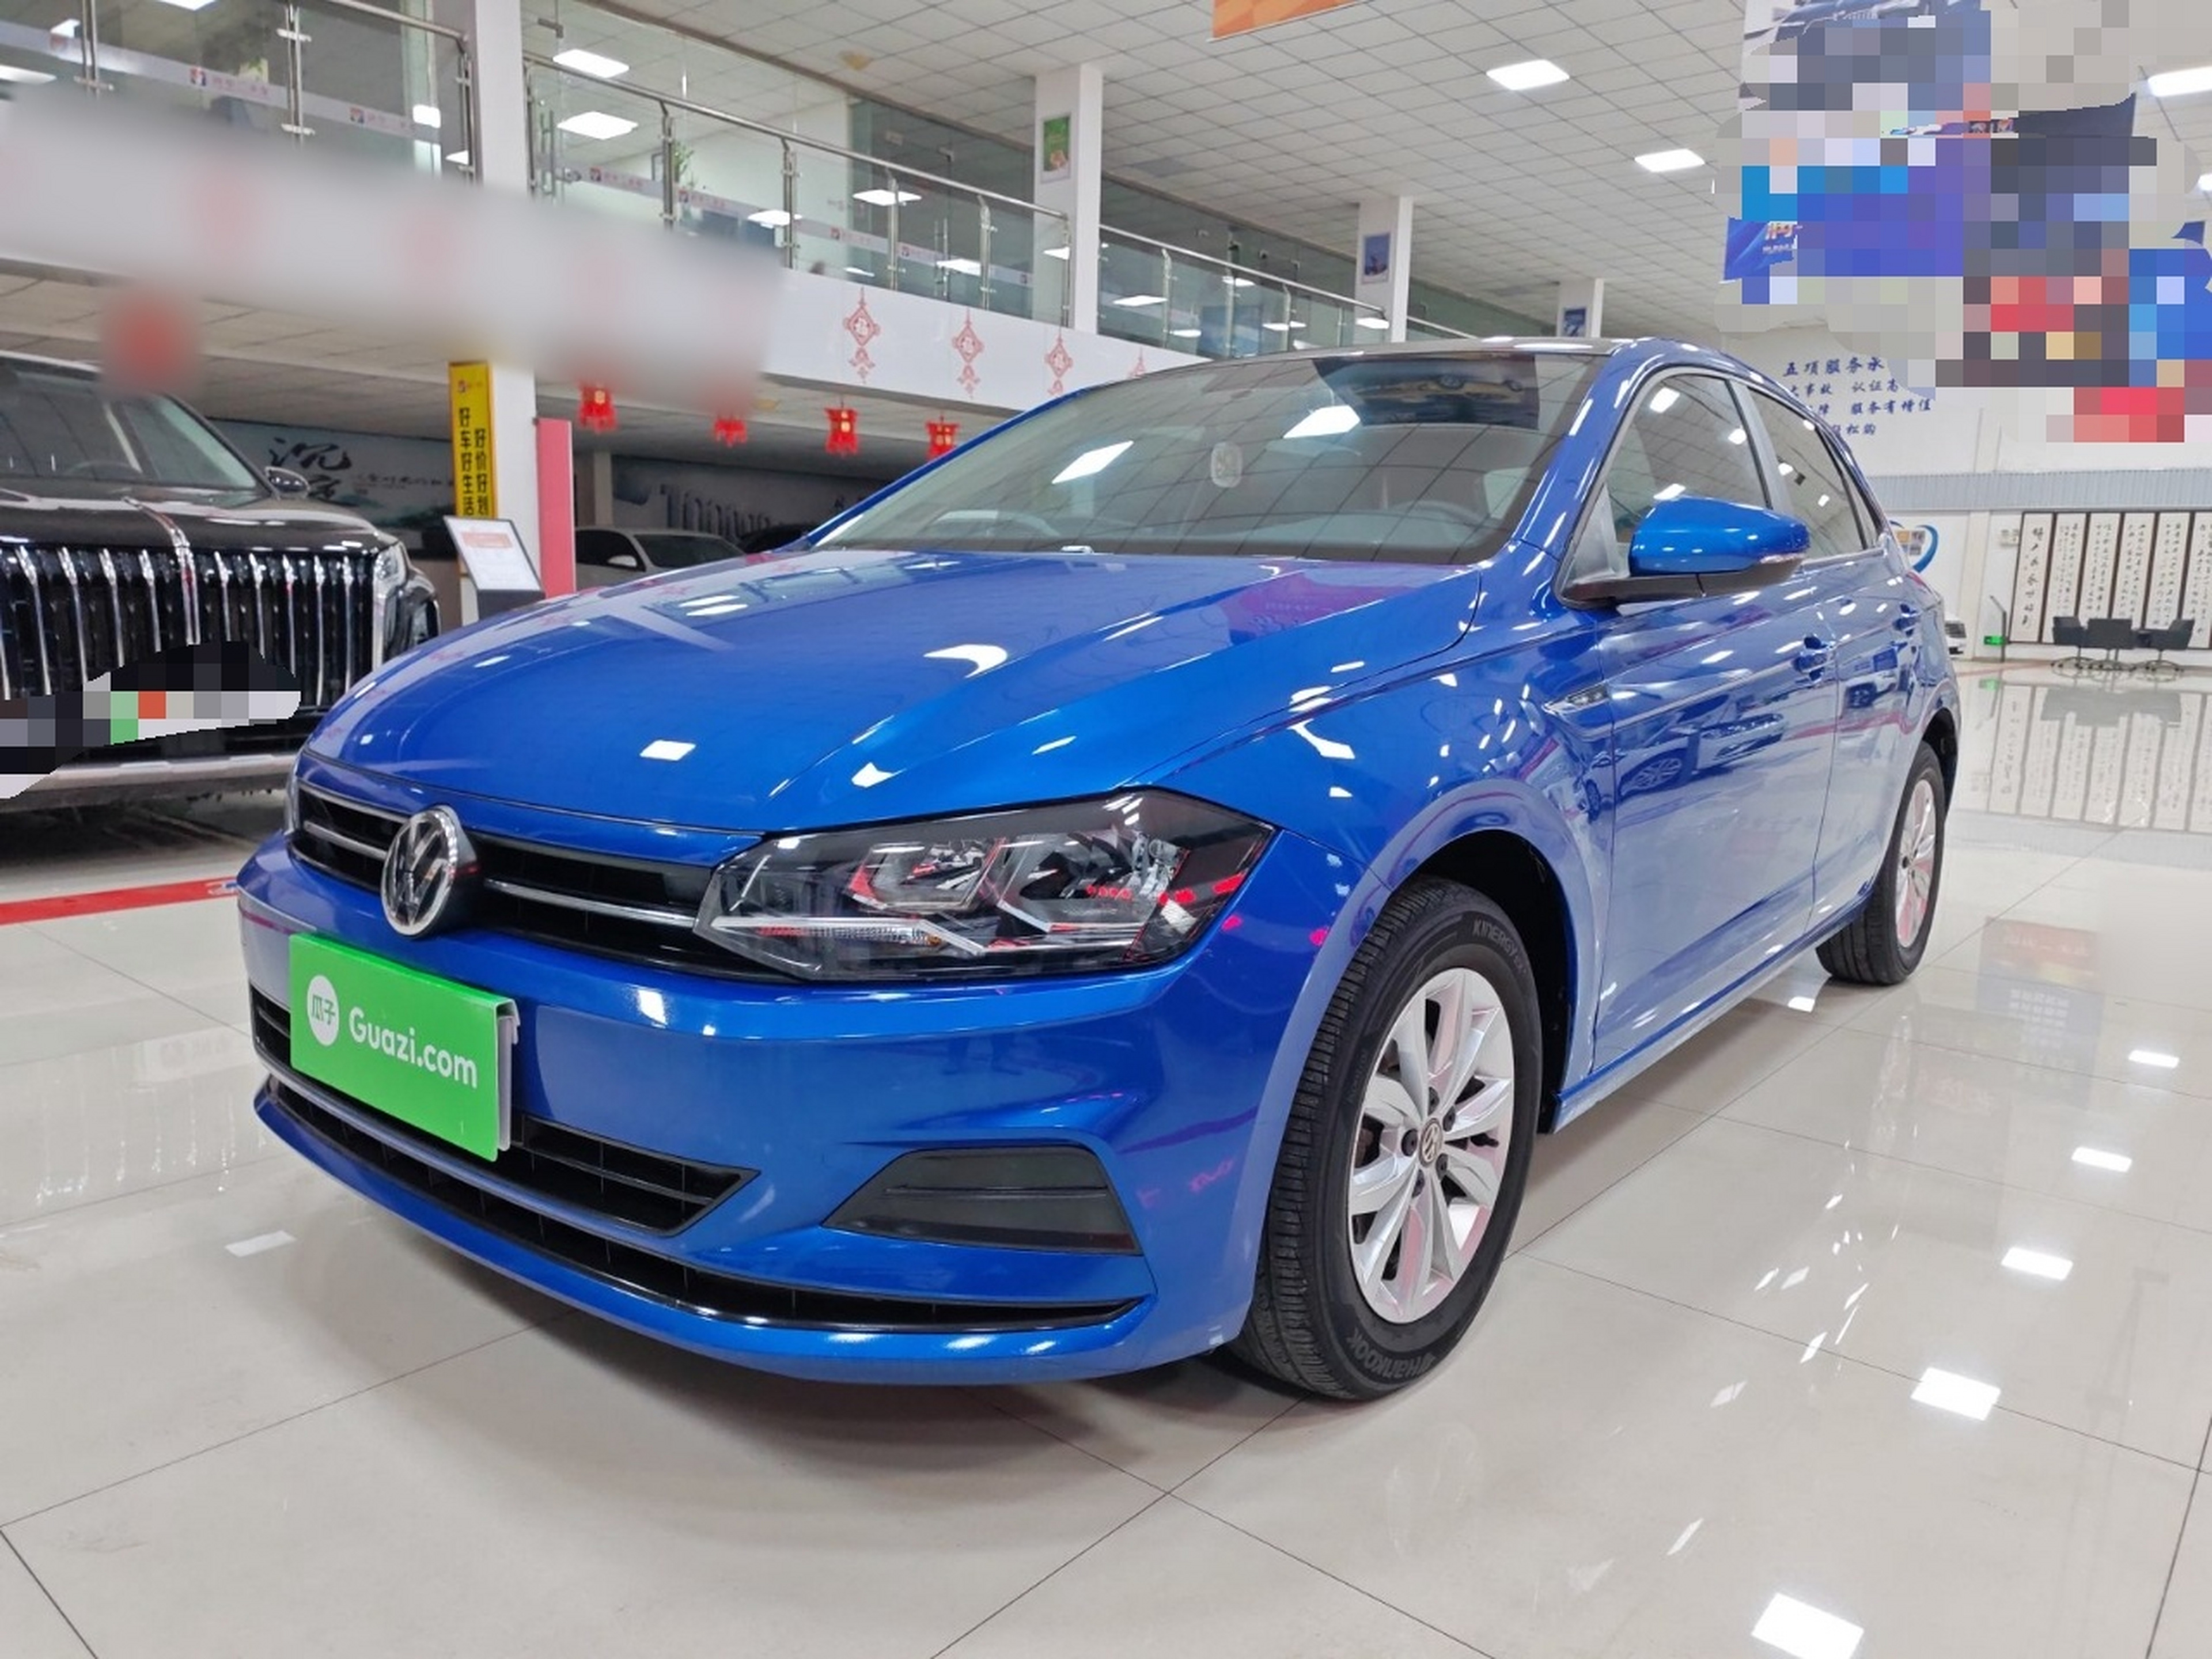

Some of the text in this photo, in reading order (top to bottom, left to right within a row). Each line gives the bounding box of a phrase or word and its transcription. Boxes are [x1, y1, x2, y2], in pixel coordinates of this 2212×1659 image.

[459, 407, 475, 516] 好车好生活
[311, 994, 336, 1026] 瓜子
[349, 1006, 478, 1090] Guazi.com
